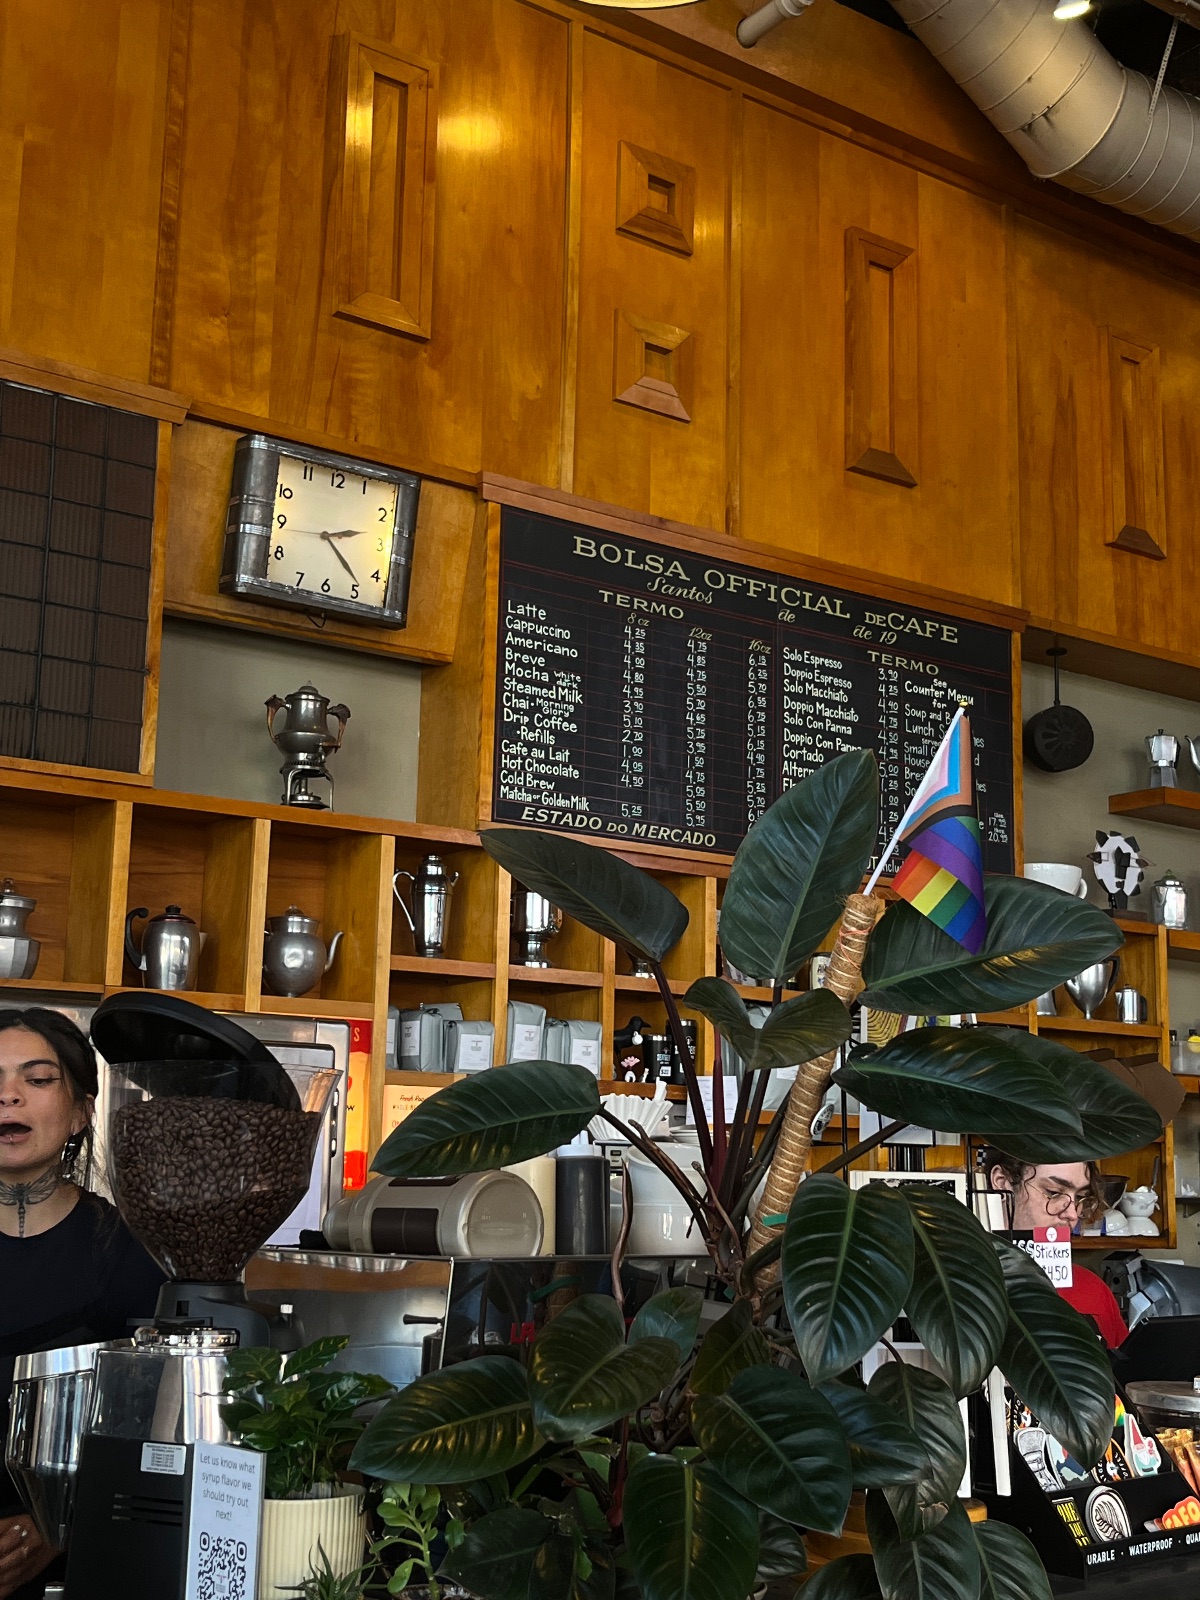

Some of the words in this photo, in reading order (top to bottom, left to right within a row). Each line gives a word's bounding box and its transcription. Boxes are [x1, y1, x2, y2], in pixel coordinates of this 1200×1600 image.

[303, 465, 313, 481] 11
[331, 472, 346, 489] 12
[279, 484, 293, 499] 10
[362, 480, 367, 495] 1
[277, 514, 287, 529] 9
[378, 508, 388, 522] 2
[376, 538, 384, 552] 3
[274, 546, 284, 560] 8
[296, 572, 305, 587] 7
[370, 569, 381, 583] 4
[573, 536, 691, 582] BOLSA
[704, 568, 851, 619] OFFICIAL
[321, 579, 331, 593] 6
[350, 585, 359, 599] 5
[508, 600, 546, 620] Latte
[598, 590, 684, 620] TERMO
[647, 577, 713, 605] Santos
[778, 608, 796, 623] de
[853, 626, 872, 640] de
[880, 632, 897, 645] 19
[506, 616, 570, 639] Cappuccino
[624, 626, 646, 640] 4.25
[505, 632, 578, 658] Americano
[624, 640, 645, 655] 4.35
[687, 640, 707, 654] 4.75
[505, 648, 546, 667] Breve
[624, 655, 645, 670] 4.00
[686, 654, 706, 668] 4.85
[748, 654, 767, 667] 6.15
[783, 647, 802, 661] Solo
[804, 651, 843, 670] Espresso
[867, 650, 939, 675] TERMO
[505, 661, 549, 682] Mocha
[623, 670, 644, 684] 4.80
[686, 668, 707, 682] 4.75
[748, 666, 768, 681] 6.25
[784, 662, 813, 682] Doppio
[814, 670, 852, 689] Espresso
[878, 668, 898, 682] 3.90
[504, 678, 556, 699] Steamed
[558, 686, 584, 704] Milk
[622, 684, 644, 699] 4.95
[686, 683, 707, 697] 5.50
[748, 681, 767, 695] 5.70
[784, 679, 803, 694] Solo
[806, 682, 848, 703] Macchiato
[878, 684, 898, 698] 4.25
[905, 681, 945, 698] Counter
[948, 688, 974, 705] Menu
[502, 692, 529, 710] Chai
[536, 698, 575, 712] Morning
[623, 700, 644, 714] 3.90
[686, 698, 706, 712] 5.70
[748, 696, 767, 709] 6.55
[784, 696, 814, 714] Doppio
[816, 702, 859, 722] Macchiato
[878, 698, 898, 714] 4.40
[932, 699, 947, 709] for
[542, 706, 570, 717] Glory
[686, 712, 706, 726] 4.65
[748, 709, 766, 723] 6.75
[904, 704, 926, 722] Soup
[930, 711, 942, 721] and
[504, 708, 530, 725] Drip
[534, 714, 578, 733] Coffee
[623, 714, 643, 729] 5.10
[784, 712, 803, 726] Solo
[806, 716, 824, 729] Con
[826, 718, 852, 735] Panna
[878, 715, 898, 729] 4.75
[906, 719, 934, 737] Lunch
[622, 730, 644, 744] 2.70
[686, 727, 706, 740] 5.75
[748, 724, 766, 738] 5.15
[784, 728, 813, 746] Doppio
[816, 734, 834, 749] Con
[878, 731, 898, 745] 4.50
[502, 740, 528, 755] Cafe
[531, 748, 545, 759] au
[549, 746, 570, 763] Lait
[624, 744, 643, 759] 1.00
[686, 742, 706, 755] 3.95
[747, 738, 765, 752] 6.15
[904, 742, 928, 756] Small
[746, 752, 765, 766] 4.40
[783, 744, 824, 762] Cortado
[878, 746, 898, 761] 4.95
[502, 754, 523, 770] Hot
[525, 758, 580, 779] Chocolate
[621, 760, 644, 774] 4.05
[688, 755, 705, 769] 1.50
[904, 754, 930, 768] House
[685, 770, 706, 785] 4.75
[748, 766, 765, 780] 1.75
[879, 762, 898, 778] 5.00
[500, 770, 524, 786] Cold
[526, 774, 555, 790] Brew
[620, 774, 644, 788] 4.50
[746, 781, 766, 794] 5.25
[881, 778, 899, 792] 1.25
[500, 785, 532, 802] Matcha
[542, 792, 570, 809] Golden
[570, 795, 590, 812] Milk
[686, 786, 706, 799] 5.05
[686, 799, 706, 813] 5.50
[746, 795, 766, 809] 5.70
[880, 794, 899, 808] 1.00
[622, 804, 643, 818] 5.25
[880, 808, 899, 824] 1.25
[521, 806, 602, 830] ESTADO
[606, 822, 628, 834] DO
[632, 823, 716, 847] MERCADO
[686, 814, 706, 827] 5.95
[878, 826, 896, 842] 4.5
[1036, 1244, 1069, 1259] Stickers
[200, 1453, 211, 1464] Let
[212, 1457, 219, 1466] us
[220, 1457, 237, 1470] know
[239, 1462, 255, 1474] what
[202, 1472, 220, 1485] syrup
[222, 1474, 241, 1488] flavor
[242, 1481, 252, 1490] we
[203, 1488, 225, 1502] should
[226, 1494, 236, 1507] try
[237, 1498, 249, 1508] out
[1128, 1538, 1173, 1556] WATERPROOF
